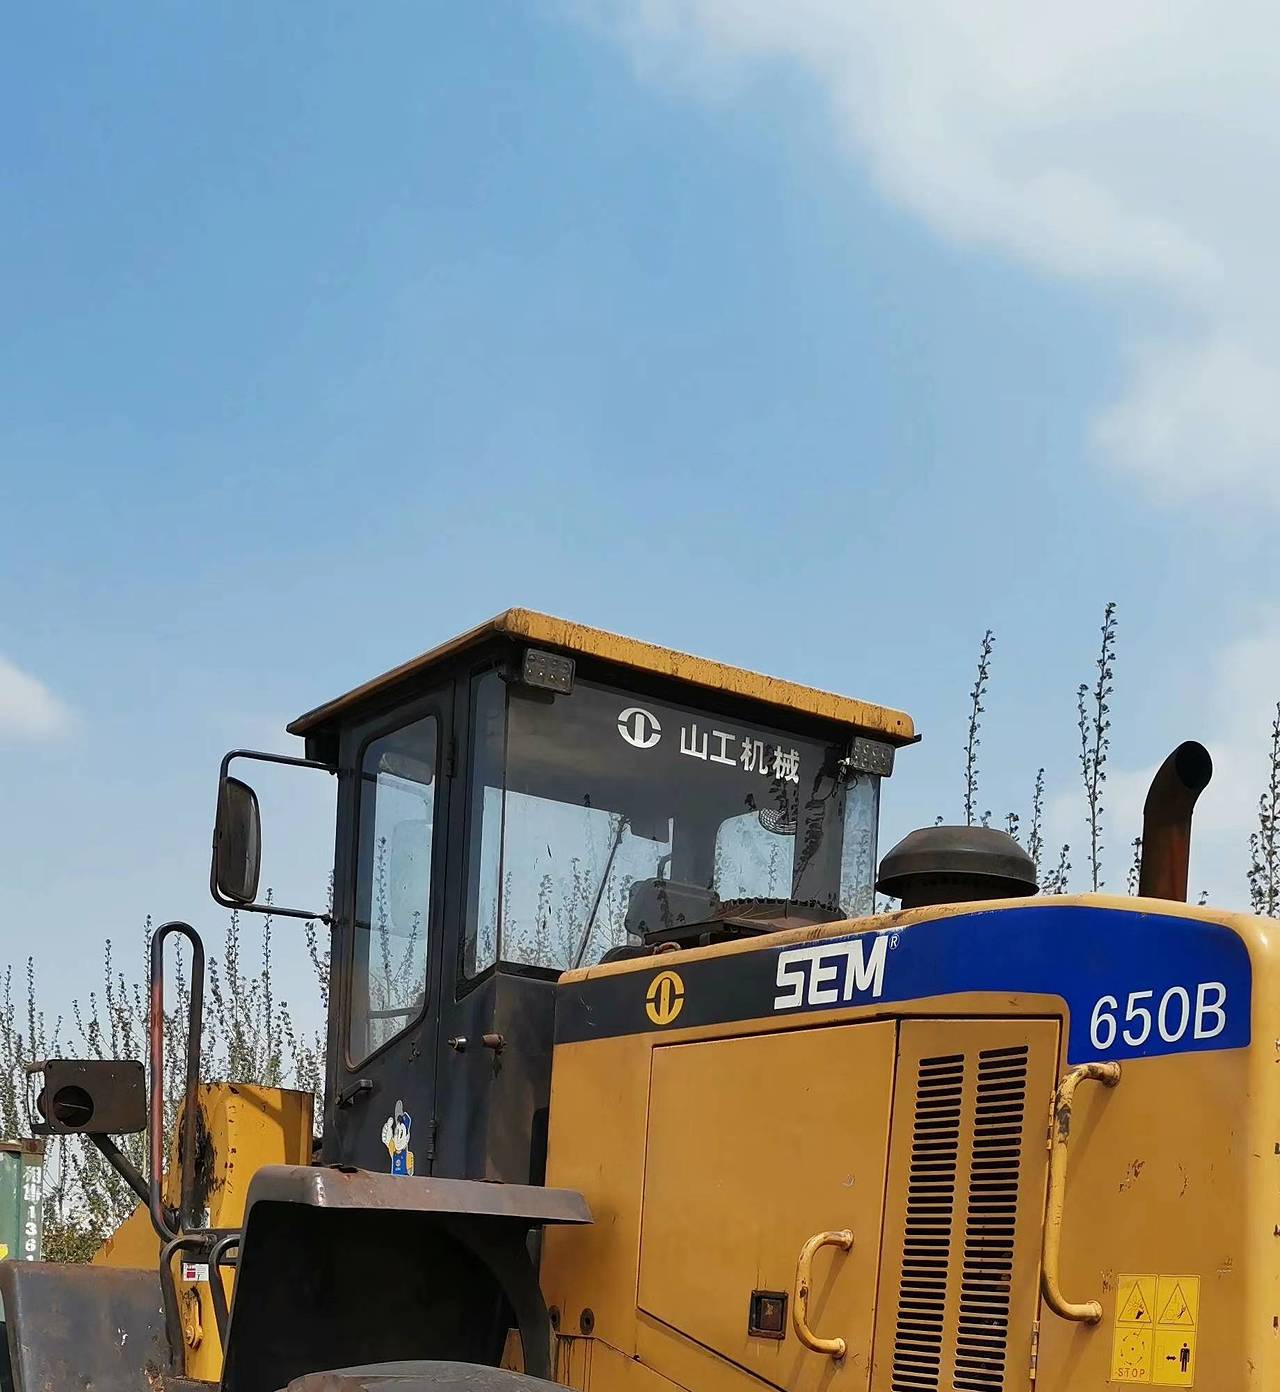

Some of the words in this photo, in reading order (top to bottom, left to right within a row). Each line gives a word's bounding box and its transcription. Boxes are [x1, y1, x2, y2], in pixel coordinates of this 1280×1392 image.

[680, 723, 800, 784] 山工机械
[774, 935, 889, 1010] SEM
[1090, 981, 1227, 1050] 650B
[1117, 1368, 1146, 1378] STOP
